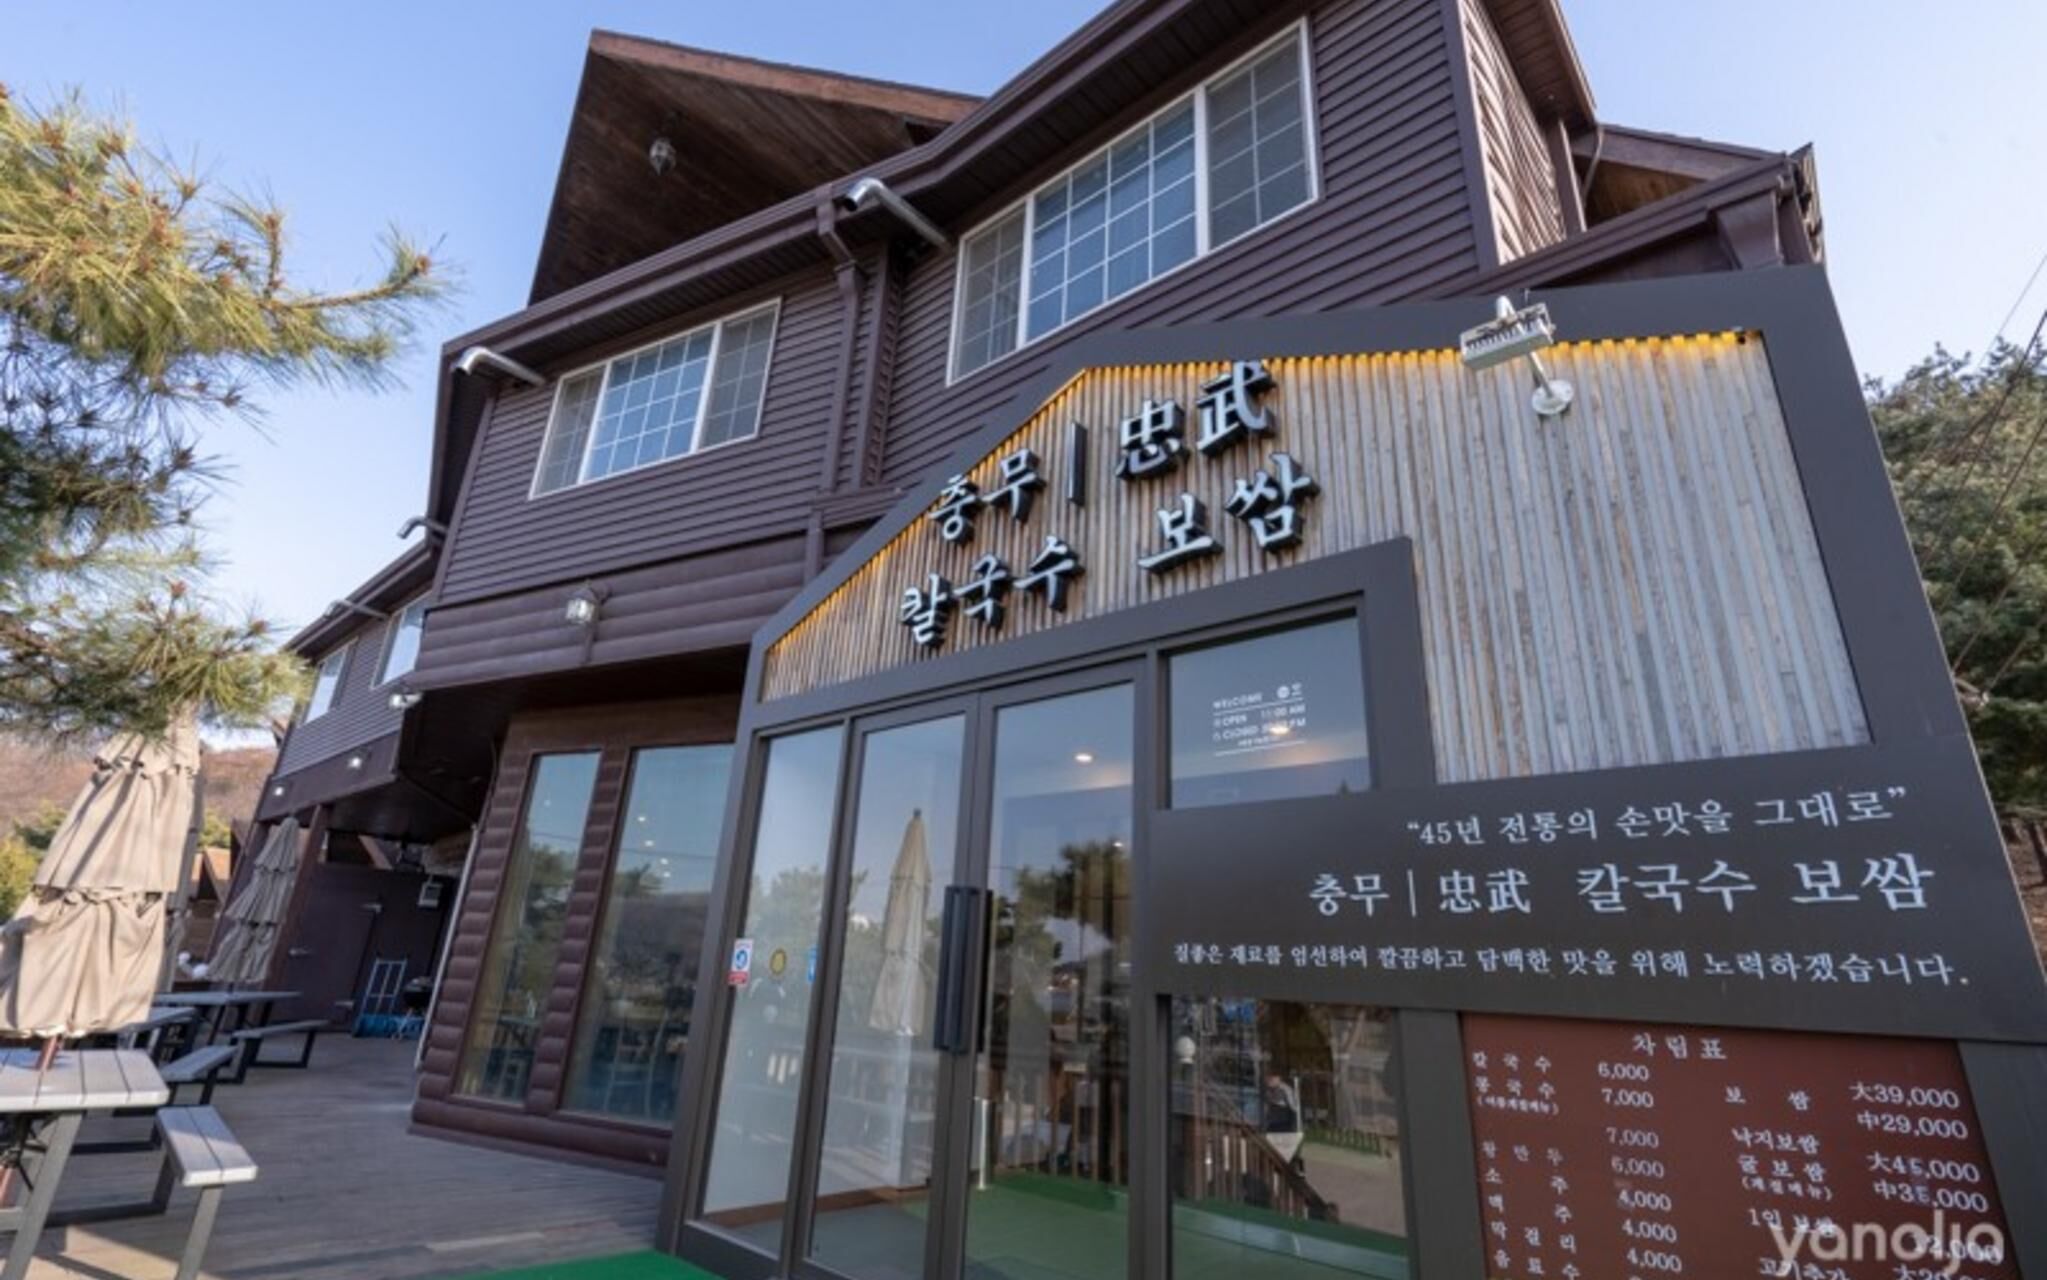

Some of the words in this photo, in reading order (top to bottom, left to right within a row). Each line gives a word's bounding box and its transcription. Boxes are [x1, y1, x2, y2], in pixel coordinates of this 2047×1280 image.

[928, 447, 1044, 543] 충무
[1116, 360, 1277, 480] 忠武
[901, 535, 1084, 646] 칼국수
[1138, 453, 1320, 574] 보쌈
[1223, 714, 1247, 726] OPEN
[1498, 806, 1598, 844] 전통의
[1616, 799, 1733, 838] 손맛을
[1309, 873, 1391, 917] 충무
[1439, 868, 1531, 915] 忠武
[1577, 860, 1758, 913] 칼국수
[1790, 853, 1935, 911] 보쌈
[1230, 944, 1283, 965] 재료를
[1291, 945, 1368, 969] 엄선하여
[1377, 946, 1466, 971] 깔끔하고
[1477, 948, 1552, 973] 담백한
[1562, 949, 1618, 976] 맛을
[1631, 949, 1688, 978] 위해
[1703, 951, 1969, 986] 노력하겠습니다.
[1598, 1062, 1650, 1081] 6,000
[1602, 1088, 1654, 1108] 7,000
[1606, 1127, 1660, 1148] 7,000
[1619, 1189, 1673, 1212] 4,000
[1622, 1218, 1677, 1243] 4,000
[1627, 1247, 1683, 1274] 4,000
